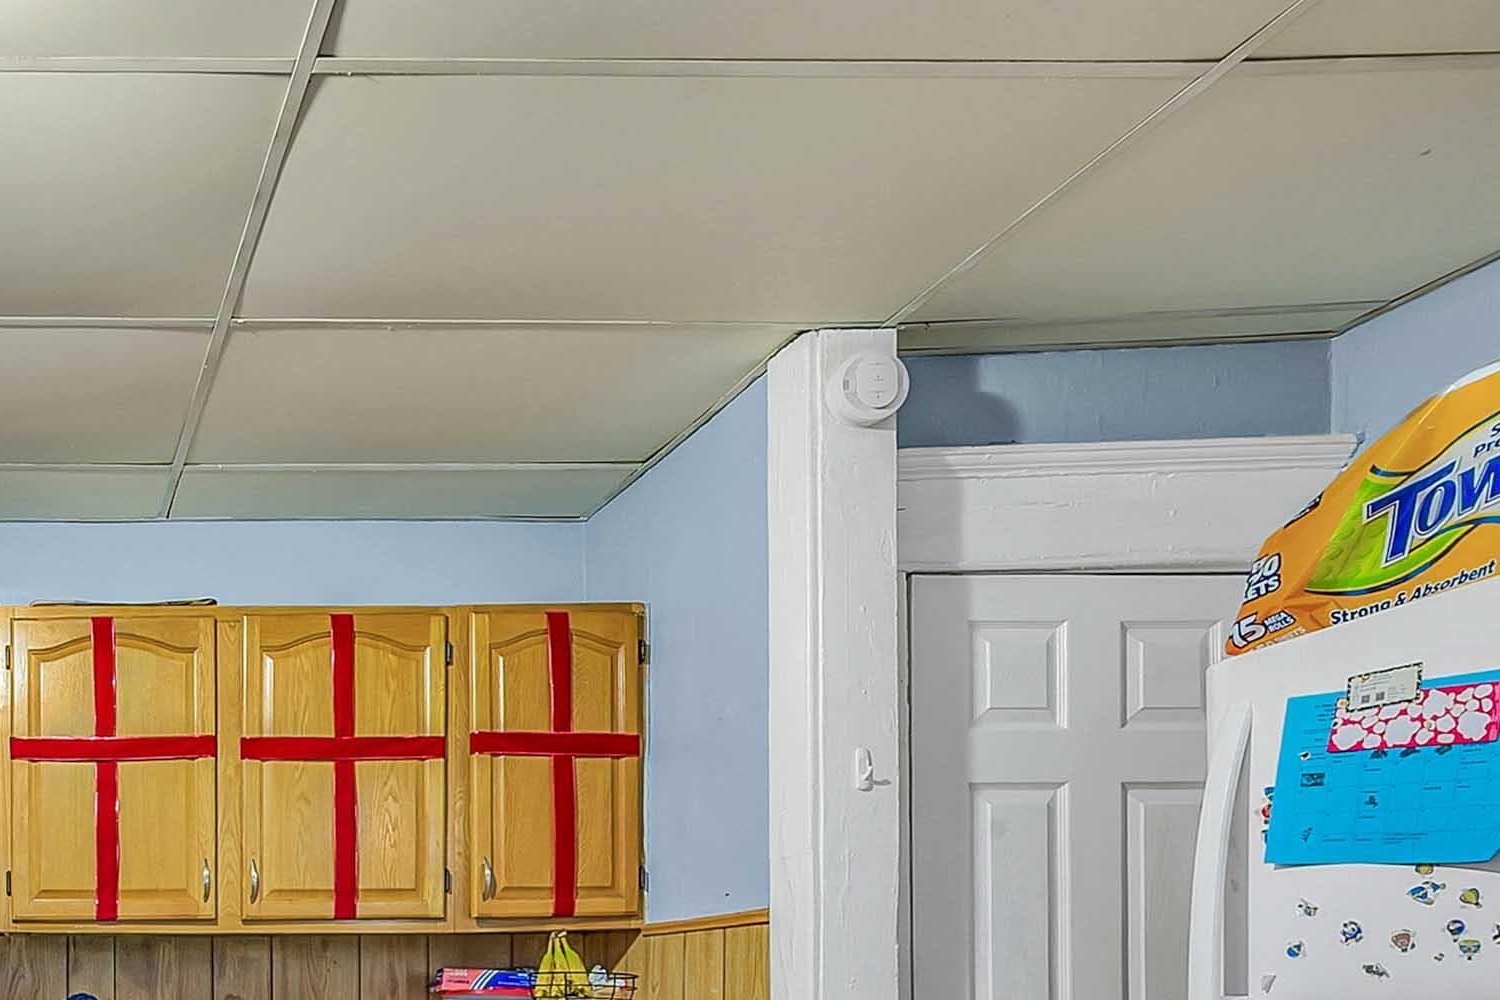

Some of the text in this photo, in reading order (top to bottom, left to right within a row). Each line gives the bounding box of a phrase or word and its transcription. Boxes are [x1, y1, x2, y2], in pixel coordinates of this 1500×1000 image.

[1394, 592, 1407, 607] &
[1408, 559, 1496, 602] Absorbent
[1230, 612, 1267, 648] 15
